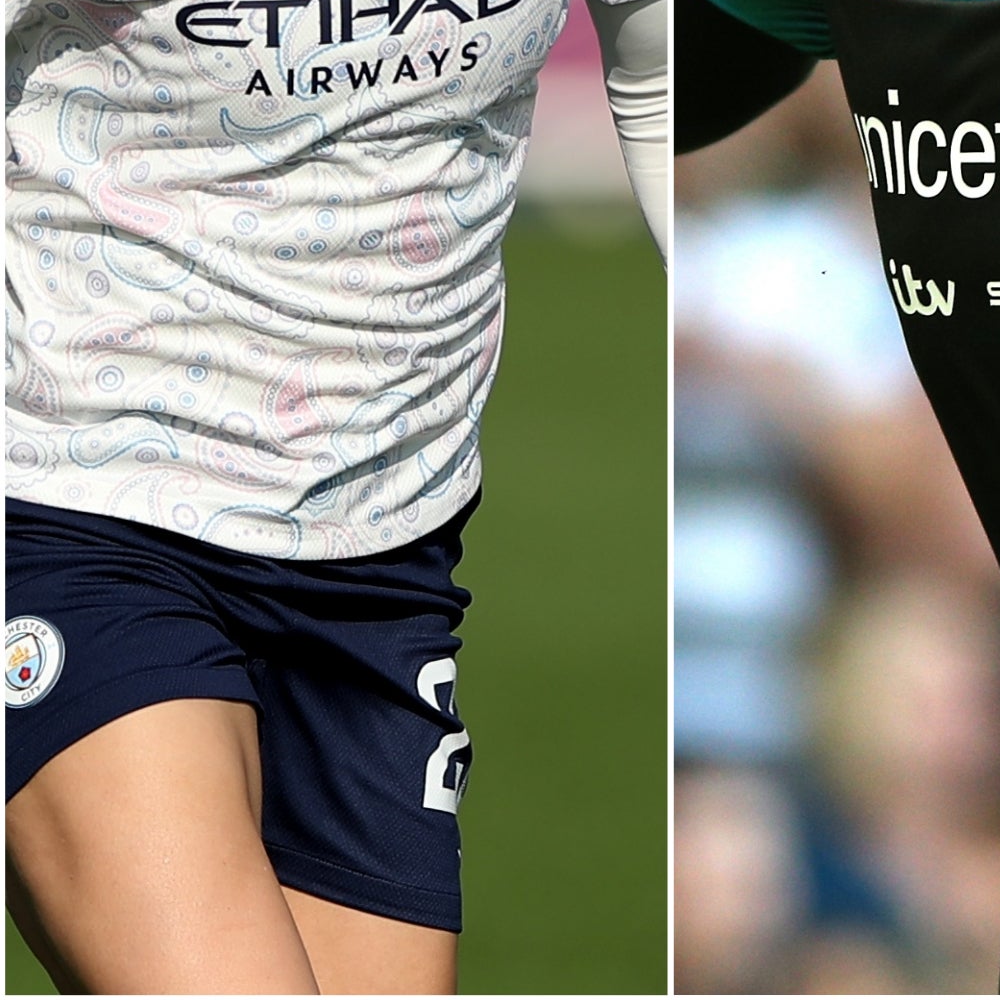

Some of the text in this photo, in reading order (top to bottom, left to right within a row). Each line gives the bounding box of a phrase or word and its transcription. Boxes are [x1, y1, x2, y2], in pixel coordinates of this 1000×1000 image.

[245, 42, 479, 97] AIRWAYS
[889, 258, 956, 317] itv
[5, 622, 48, 640] HESTER
[21, 684, 41, 702] CITY
